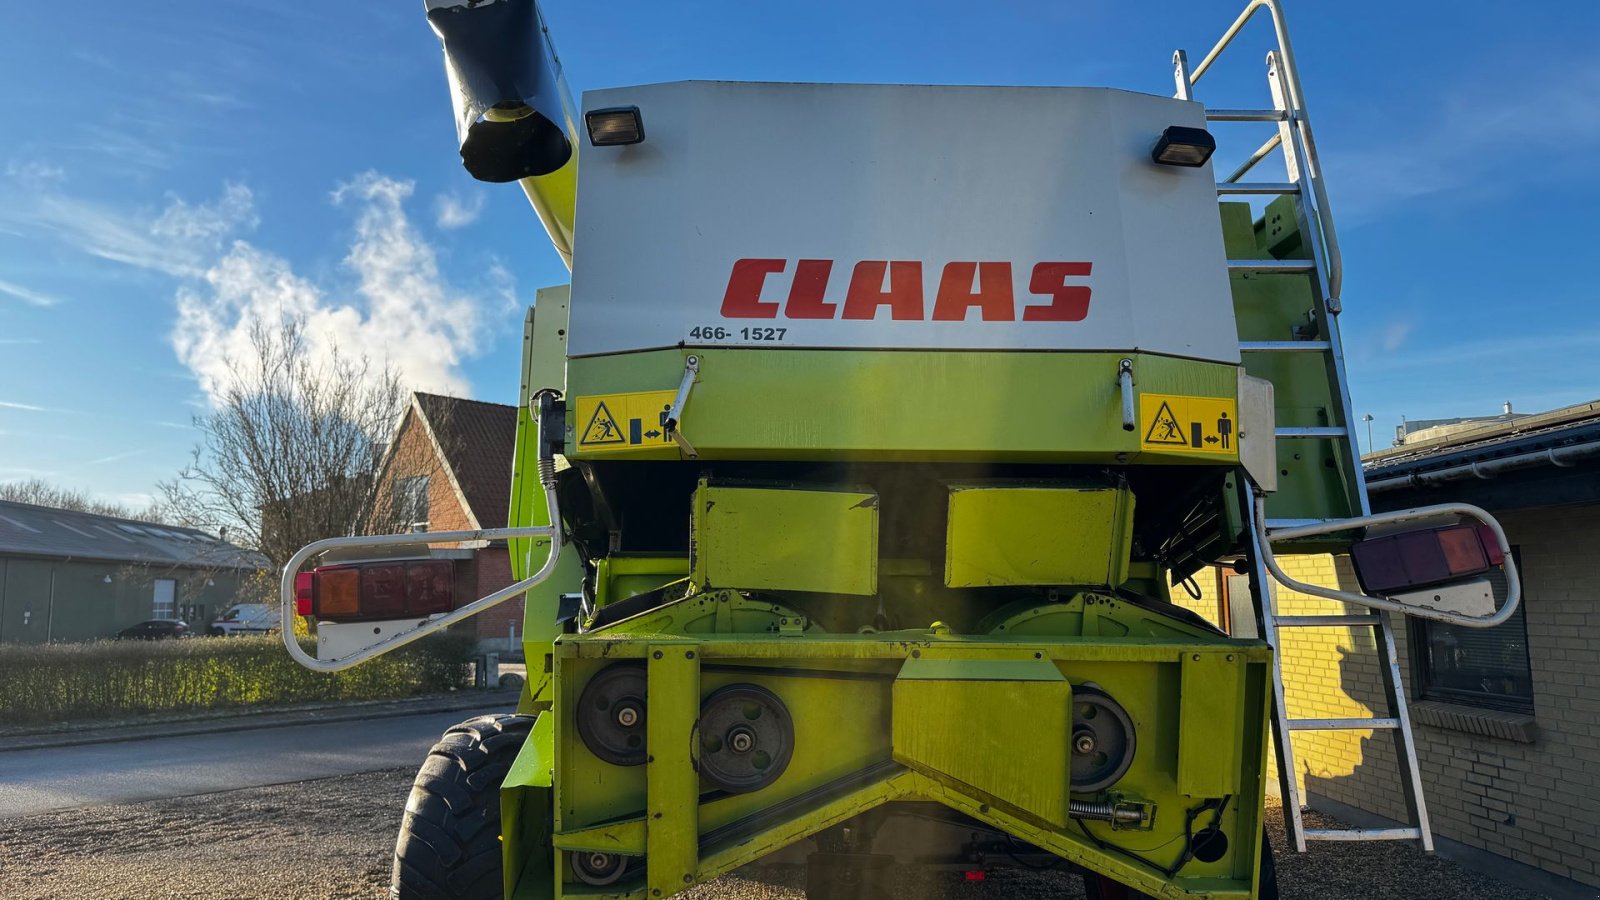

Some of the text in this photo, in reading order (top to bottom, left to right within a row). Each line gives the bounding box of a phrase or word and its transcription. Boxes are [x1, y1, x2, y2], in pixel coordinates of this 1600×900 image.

[720, 258, 1092, 322] CLAAS
[690, 326, 787, 341] 466- 1527
